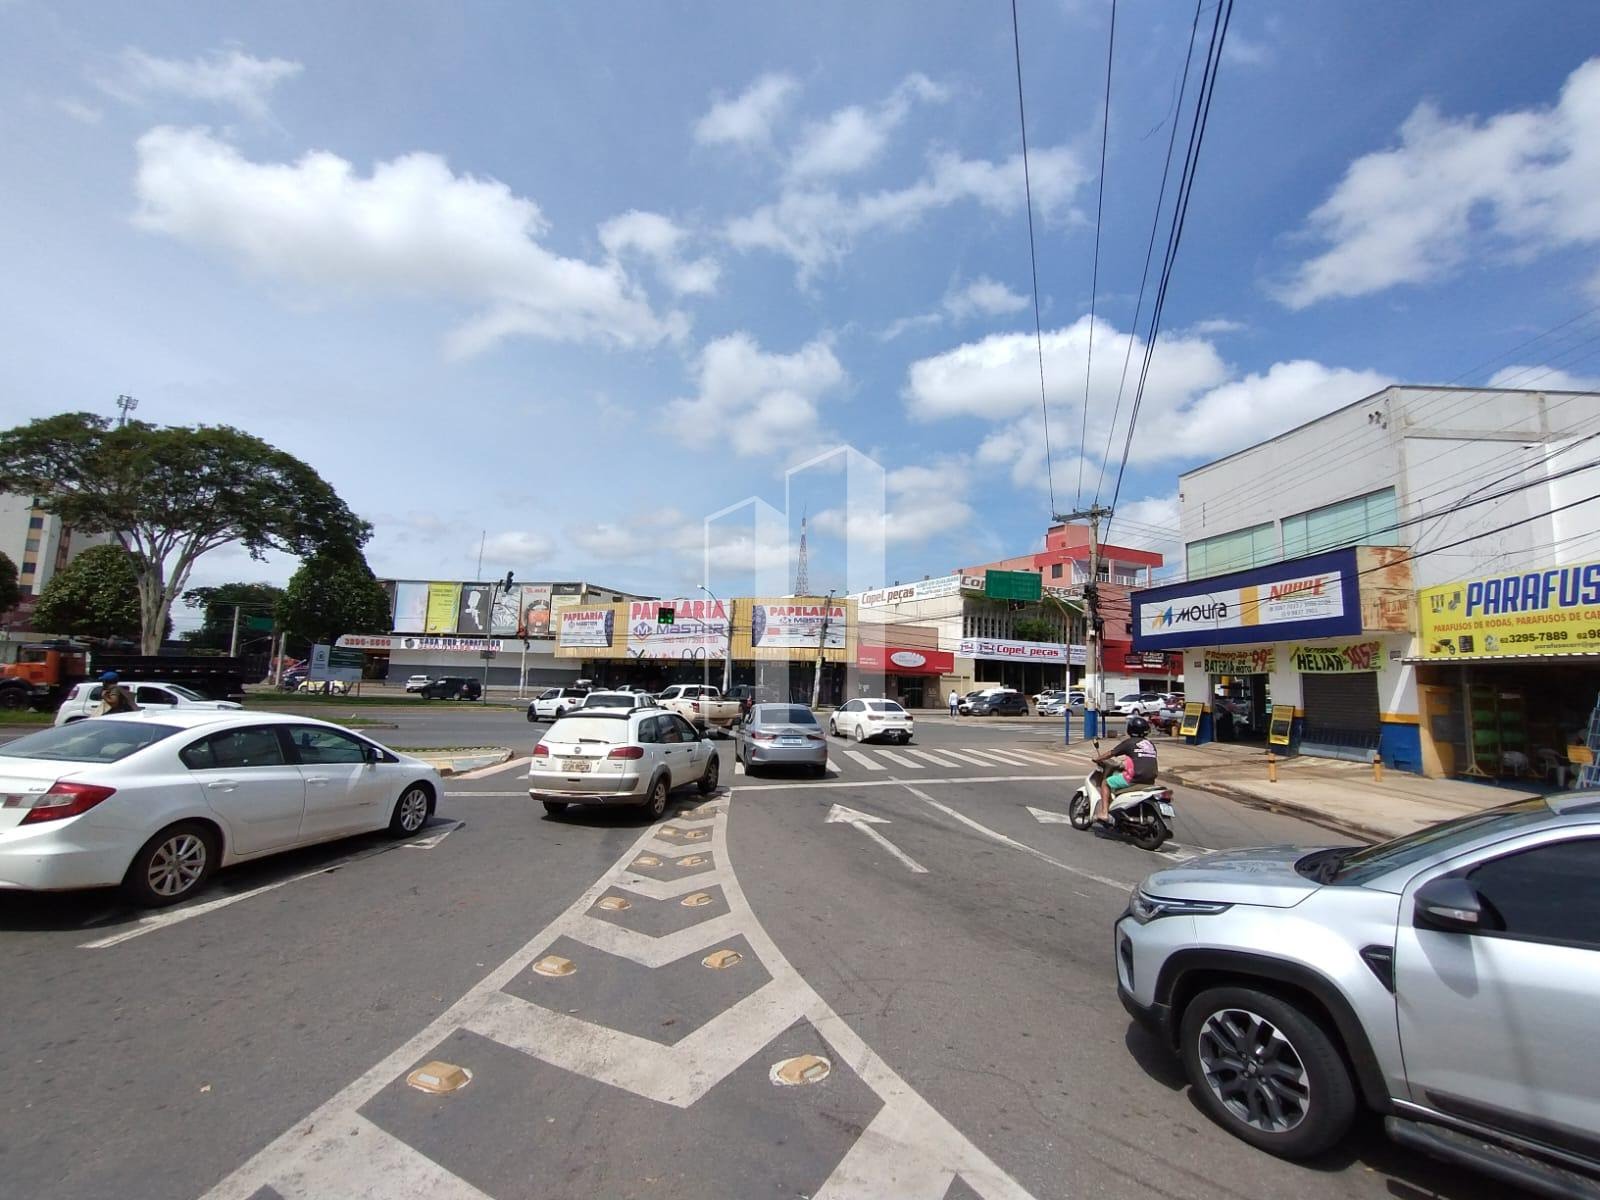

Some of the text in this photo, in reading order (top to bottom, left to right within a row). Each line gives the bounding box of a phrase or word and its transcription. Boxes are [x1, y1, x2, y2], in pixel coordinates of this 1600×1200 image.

[564, 612, 603, 621] PAPELARIA
[770, 607, 843, 616] PAPELARIA
[1434, 624, 1472, 632] PARAFUSOS
[1516, 614, 1566, 624] PARAFUSOS
[1569, 612, 1581, 621] DE
[1509, 631, 1568, 643] 3295-7889
[1205, 659, 1235, 673] BATERIA
[1297, 654, 1344, 671] HELIAR
